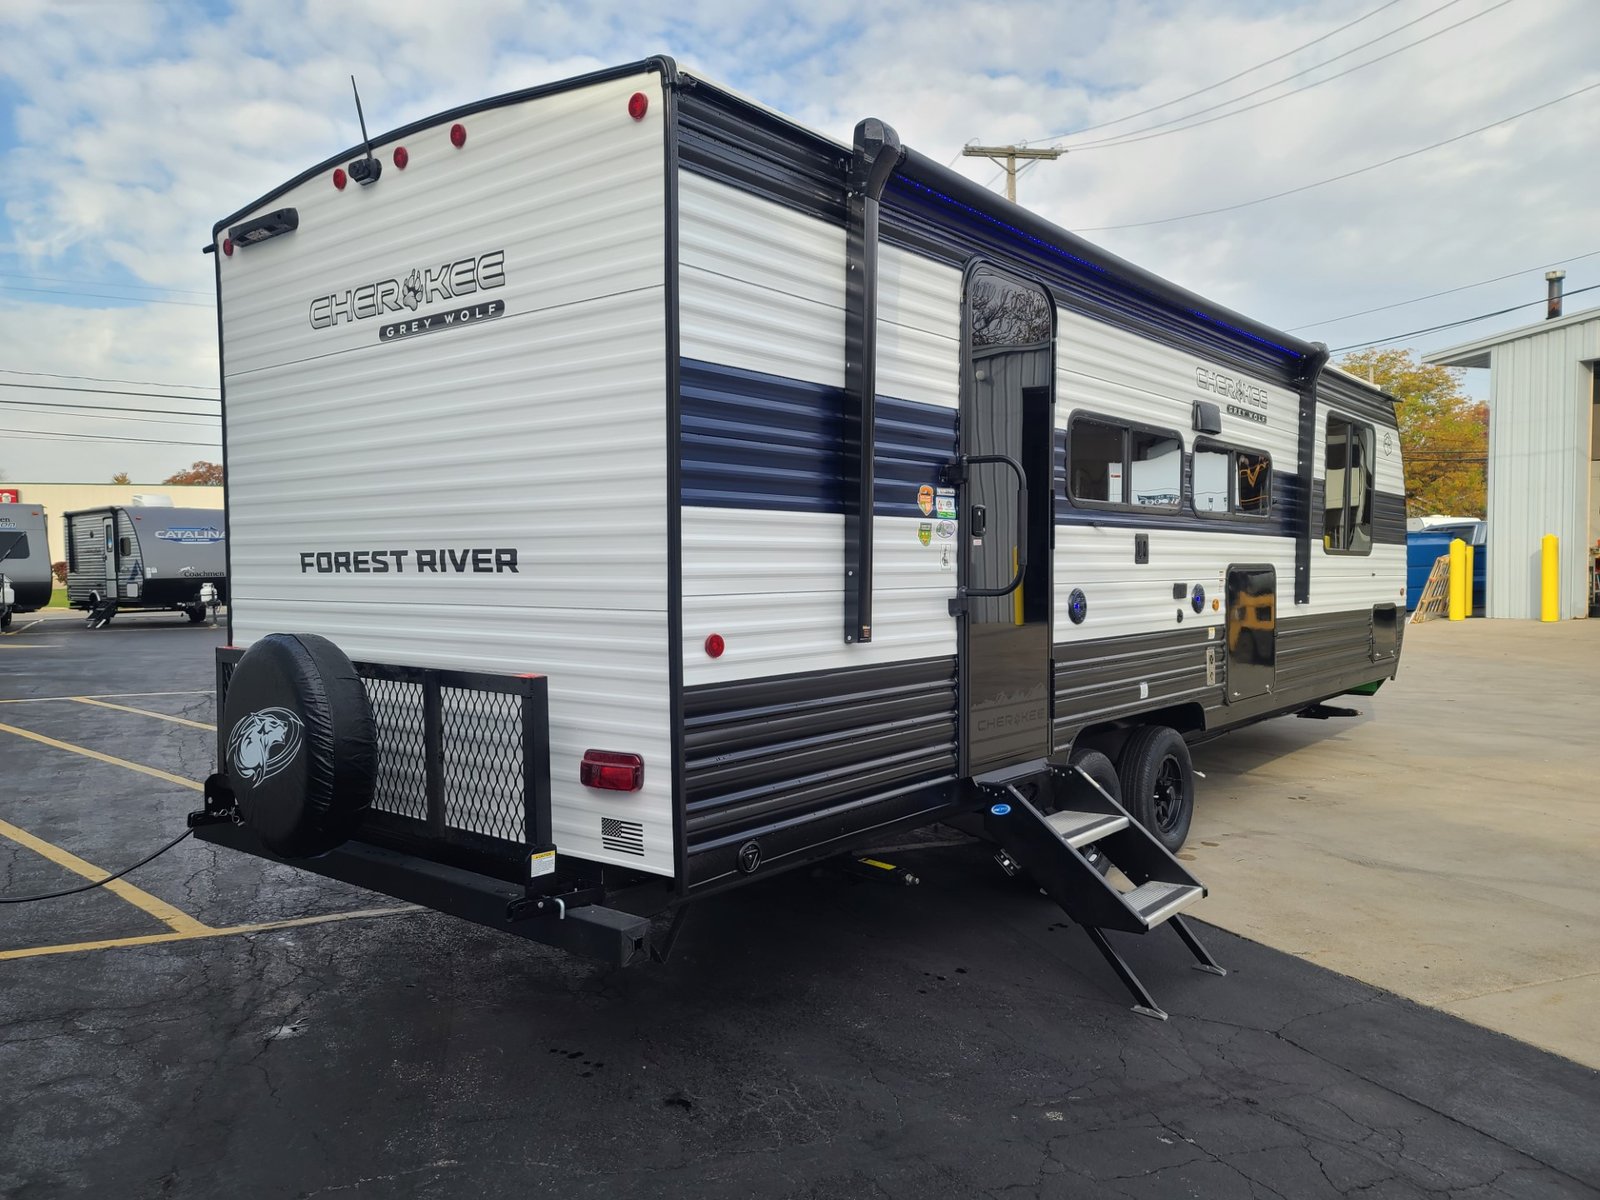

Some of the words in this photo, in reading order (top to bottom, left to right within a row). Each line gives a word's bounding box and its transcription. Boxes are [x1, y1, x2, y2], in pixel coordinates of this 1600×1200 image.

[309, 249, 506, 330] CHEROKEE
[386, 318, 432, 338] GREY
[444, 303, 497, 324] WOLF
[1196, 367, 1267, 409] CHEROKEE
[1228, 406, 1246, 416] GREY
[1249, 412, 1266, 422] WOLF
[300, 550, 408, 573] FOREST
[415, 548, 519, 573] RIVER
